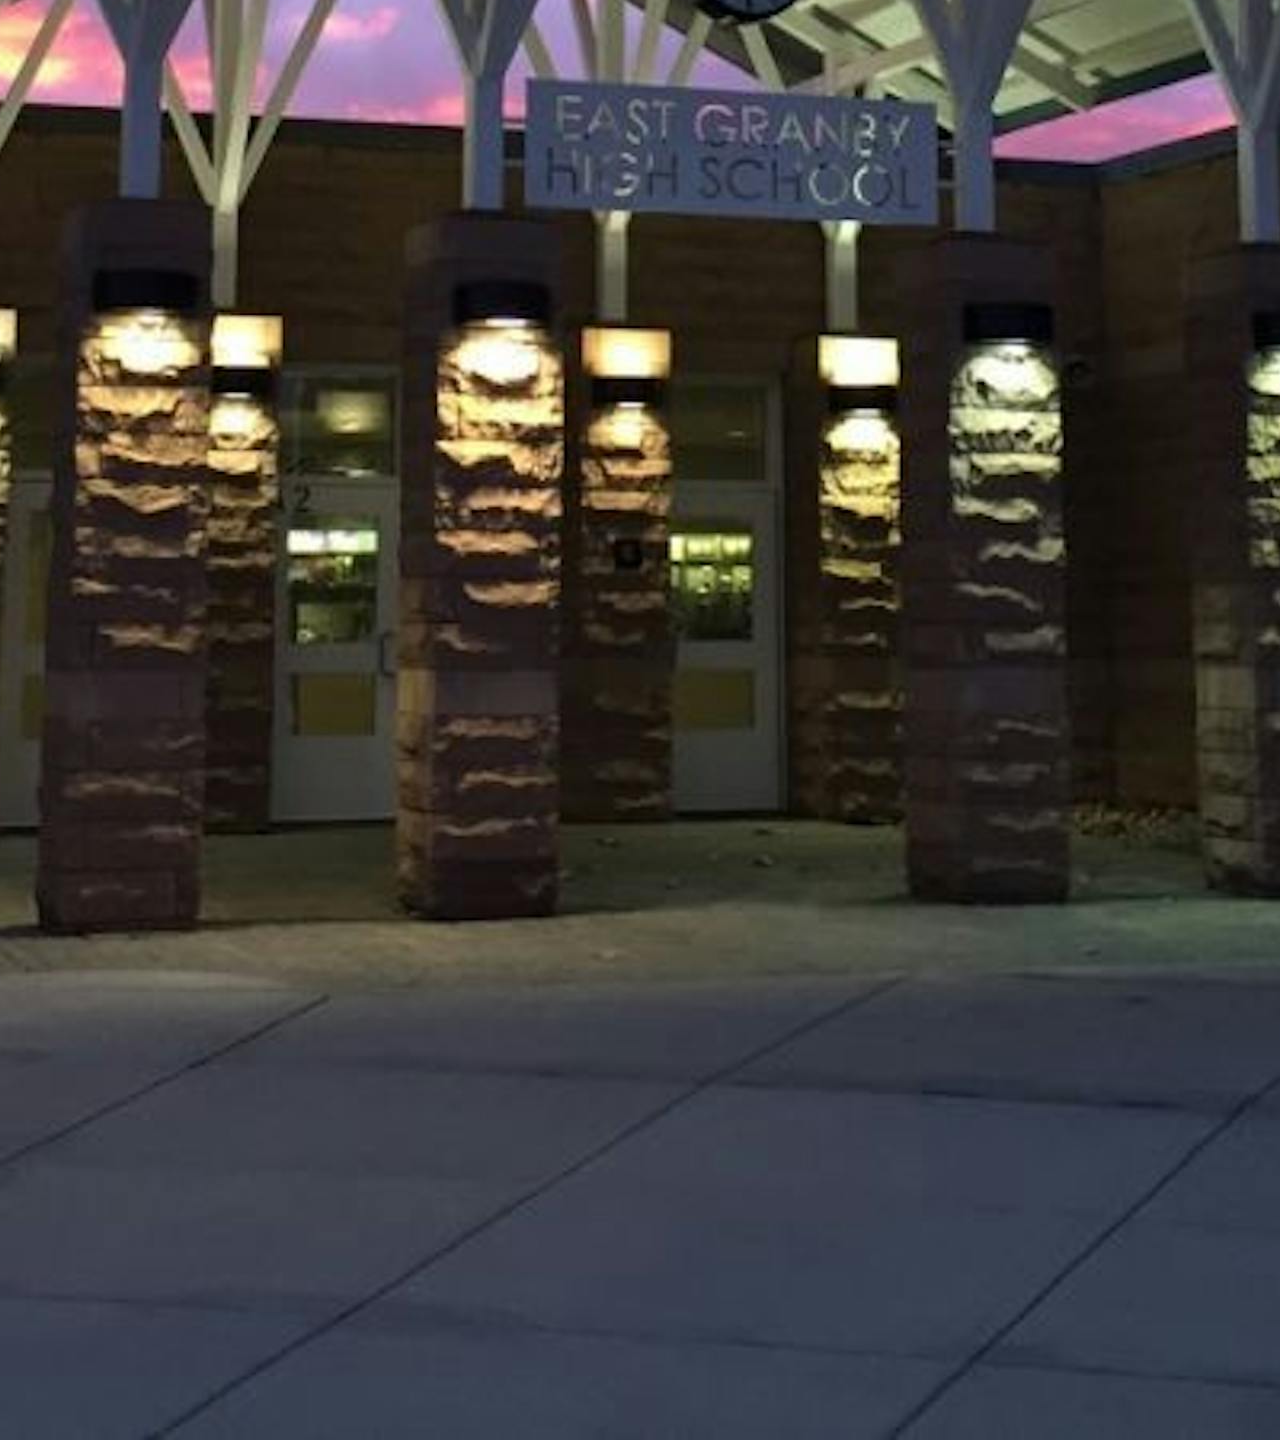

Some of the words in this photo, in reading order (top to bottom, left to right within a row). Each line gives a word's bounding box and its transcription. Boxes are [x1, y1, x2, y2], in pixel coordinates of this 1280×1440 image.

[555, 94, 679, 146] EAST
[694, 103, 911, 158] GRANBY
[546, 147, 679, 198] HIGH
[699, 157, 920, 209] SCHOOL
